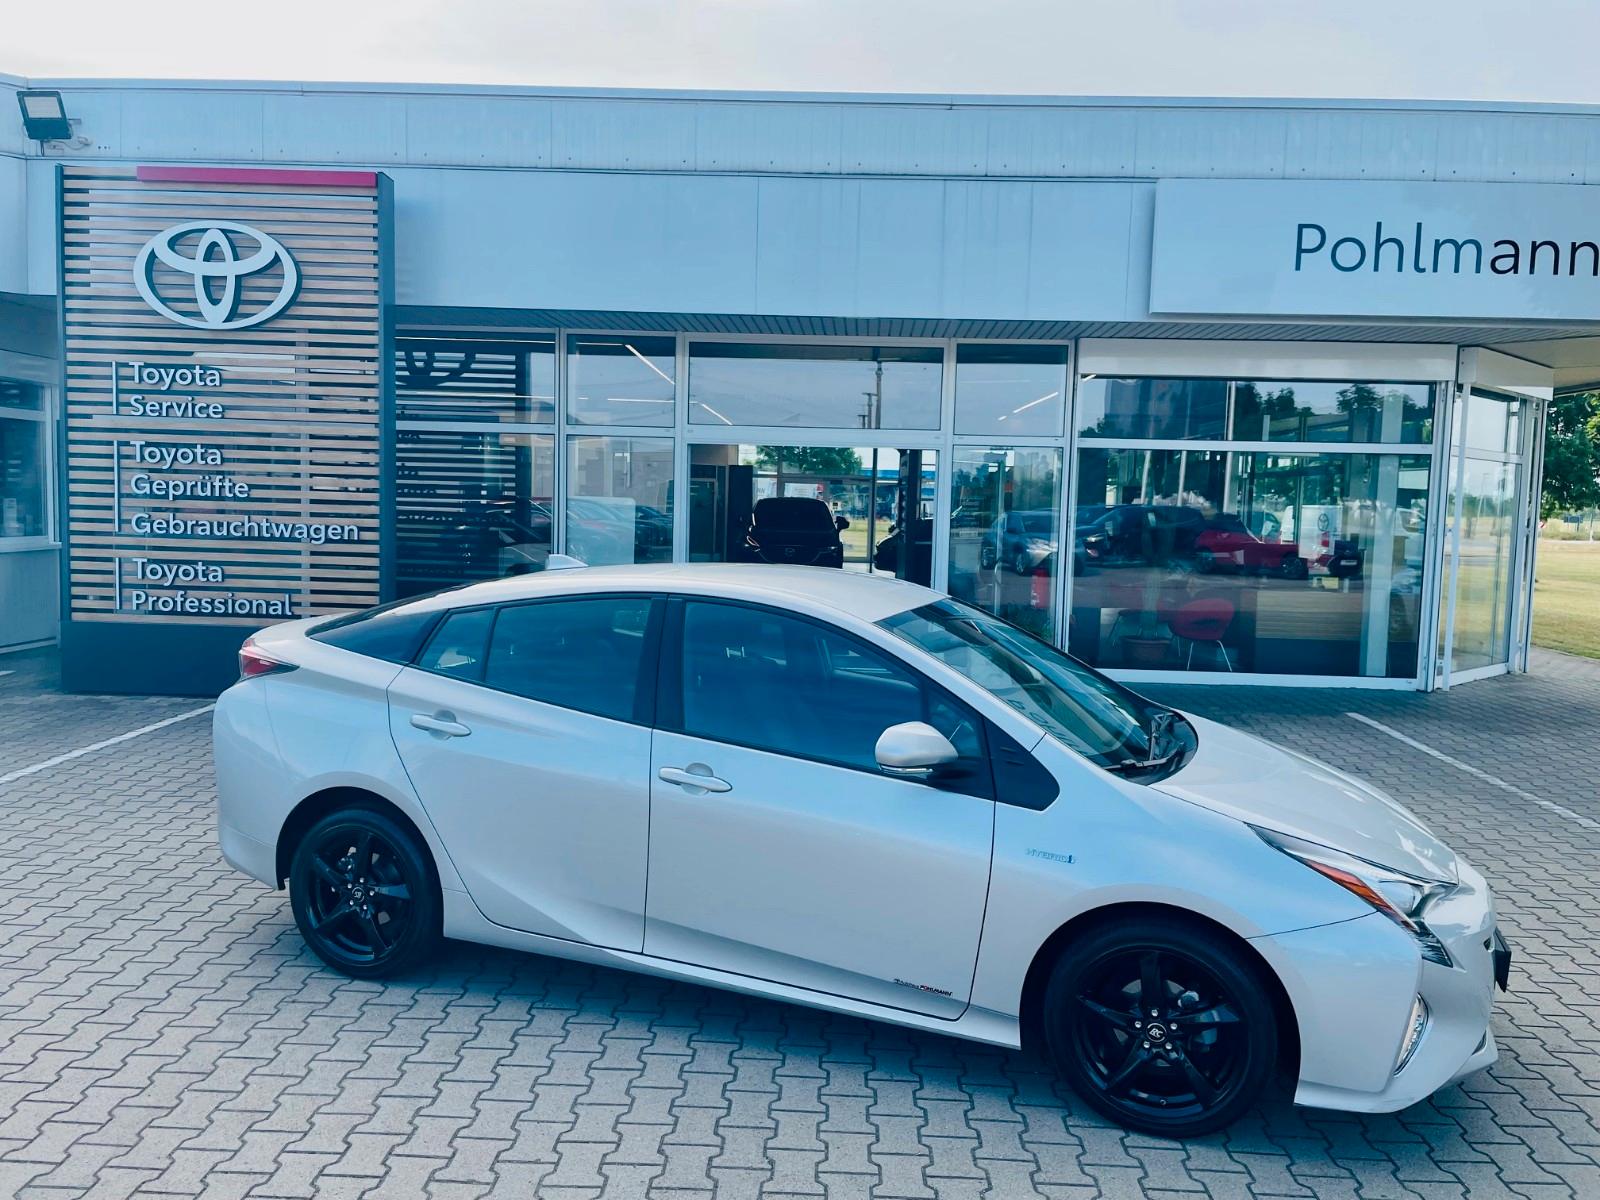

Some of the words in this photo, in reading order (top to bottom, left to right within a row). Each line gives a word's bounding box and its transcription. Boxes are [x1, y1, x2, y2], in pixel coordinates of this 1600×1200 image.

[1295, 221, 1600, 276] Pohlmann
[128, 361, 221, 390] Toyota
[129, 394, 223, 419] Service
[129, 440, 222, 469] Toyota
[130, 474, 249, 500] Geprüfte
[131, 513, 360, 545] Gebrauchtwagen
[132, 557, 224, 587] Toyota
[131, 591, 293, 616] Professional
